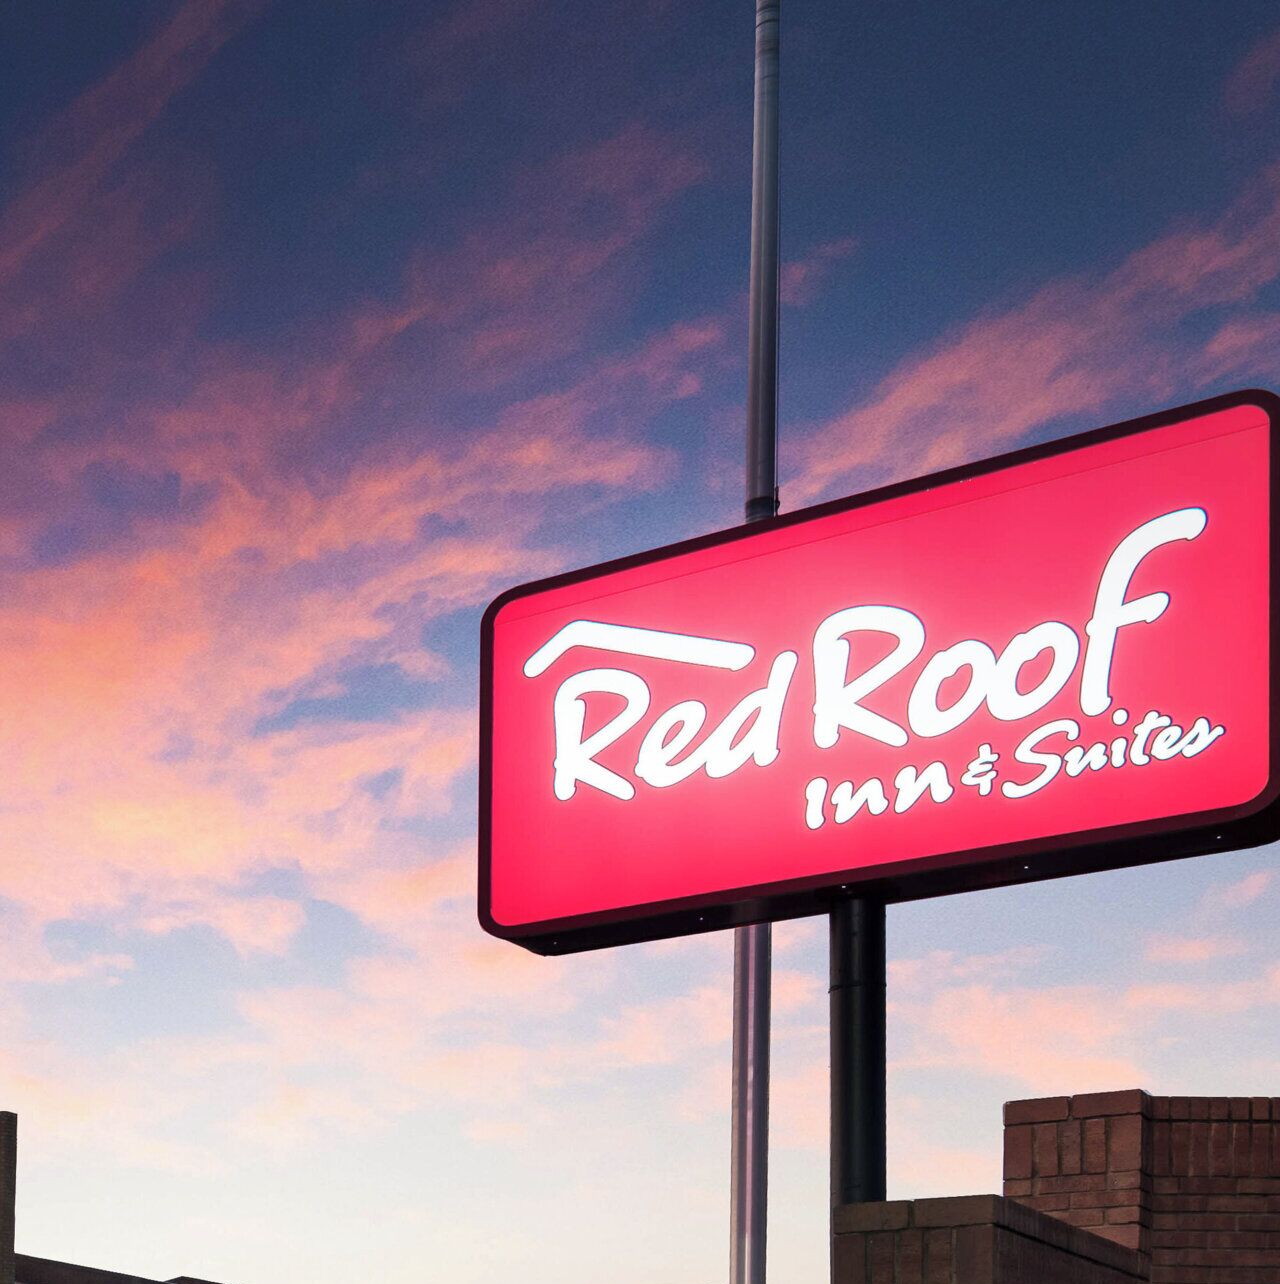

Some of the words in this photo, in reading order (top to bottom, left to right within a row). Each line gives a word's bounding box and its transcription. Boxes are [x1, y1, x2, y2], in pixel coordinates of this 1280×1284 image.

[554, 650, 798, 801] Red
[813, 509, 1207, 748] Roof
[805, 760, 954, 830] Inn
[961, 744, 999, 797] &
[1002, 710, 1224, 799] Suites
